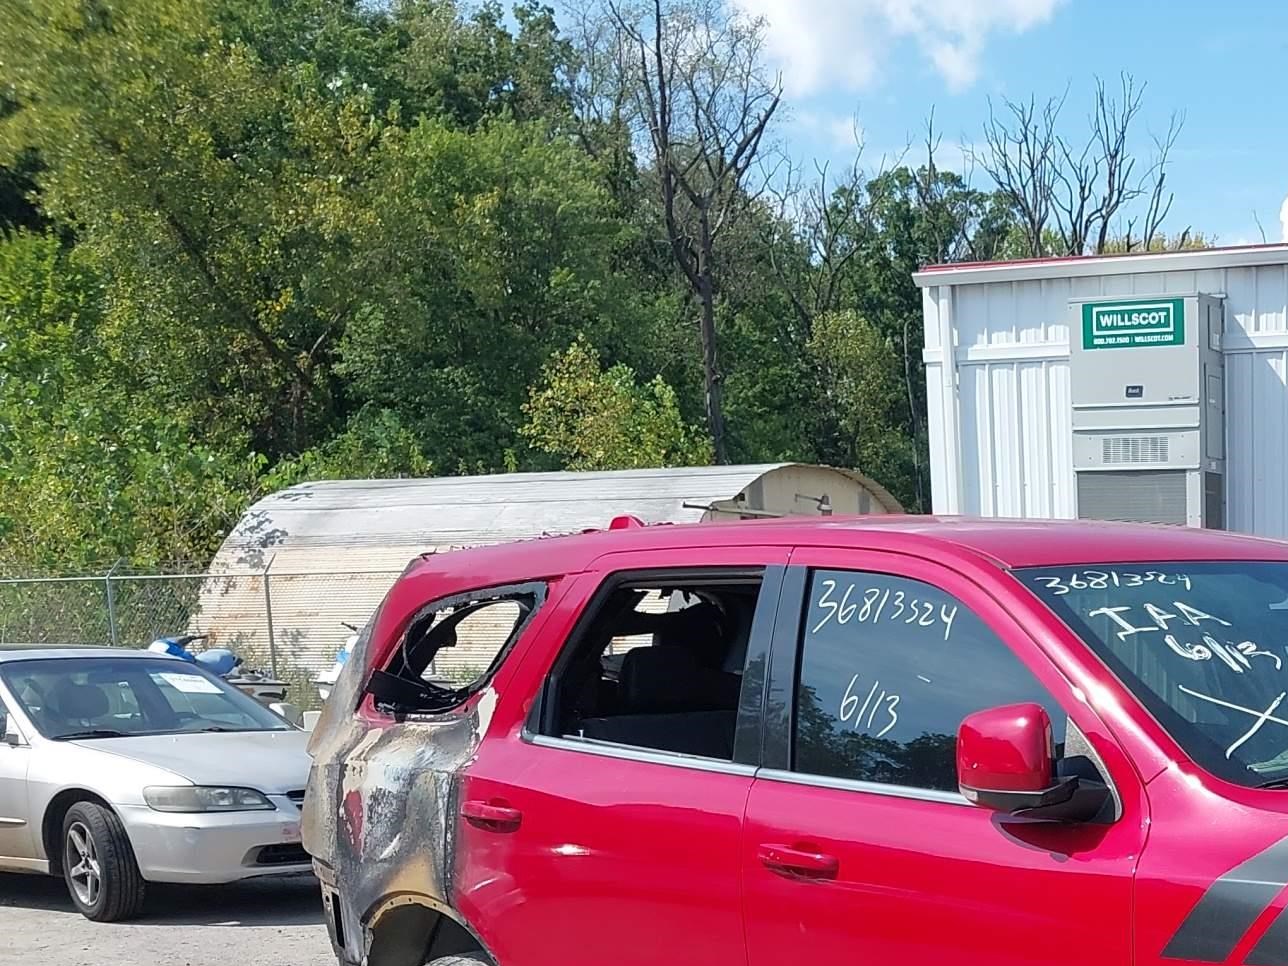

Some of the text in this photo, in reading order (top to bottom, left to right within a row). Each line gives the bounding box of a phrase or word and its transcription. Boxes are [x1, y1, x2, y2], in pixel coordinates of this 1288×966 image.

[1100, 311, 1168, 328] WILLSCOT
[812, 579, 957, 640] 36813524
[1089, 600, 1232, 642] IAA
[840, 673, 900, 738] 6/13
